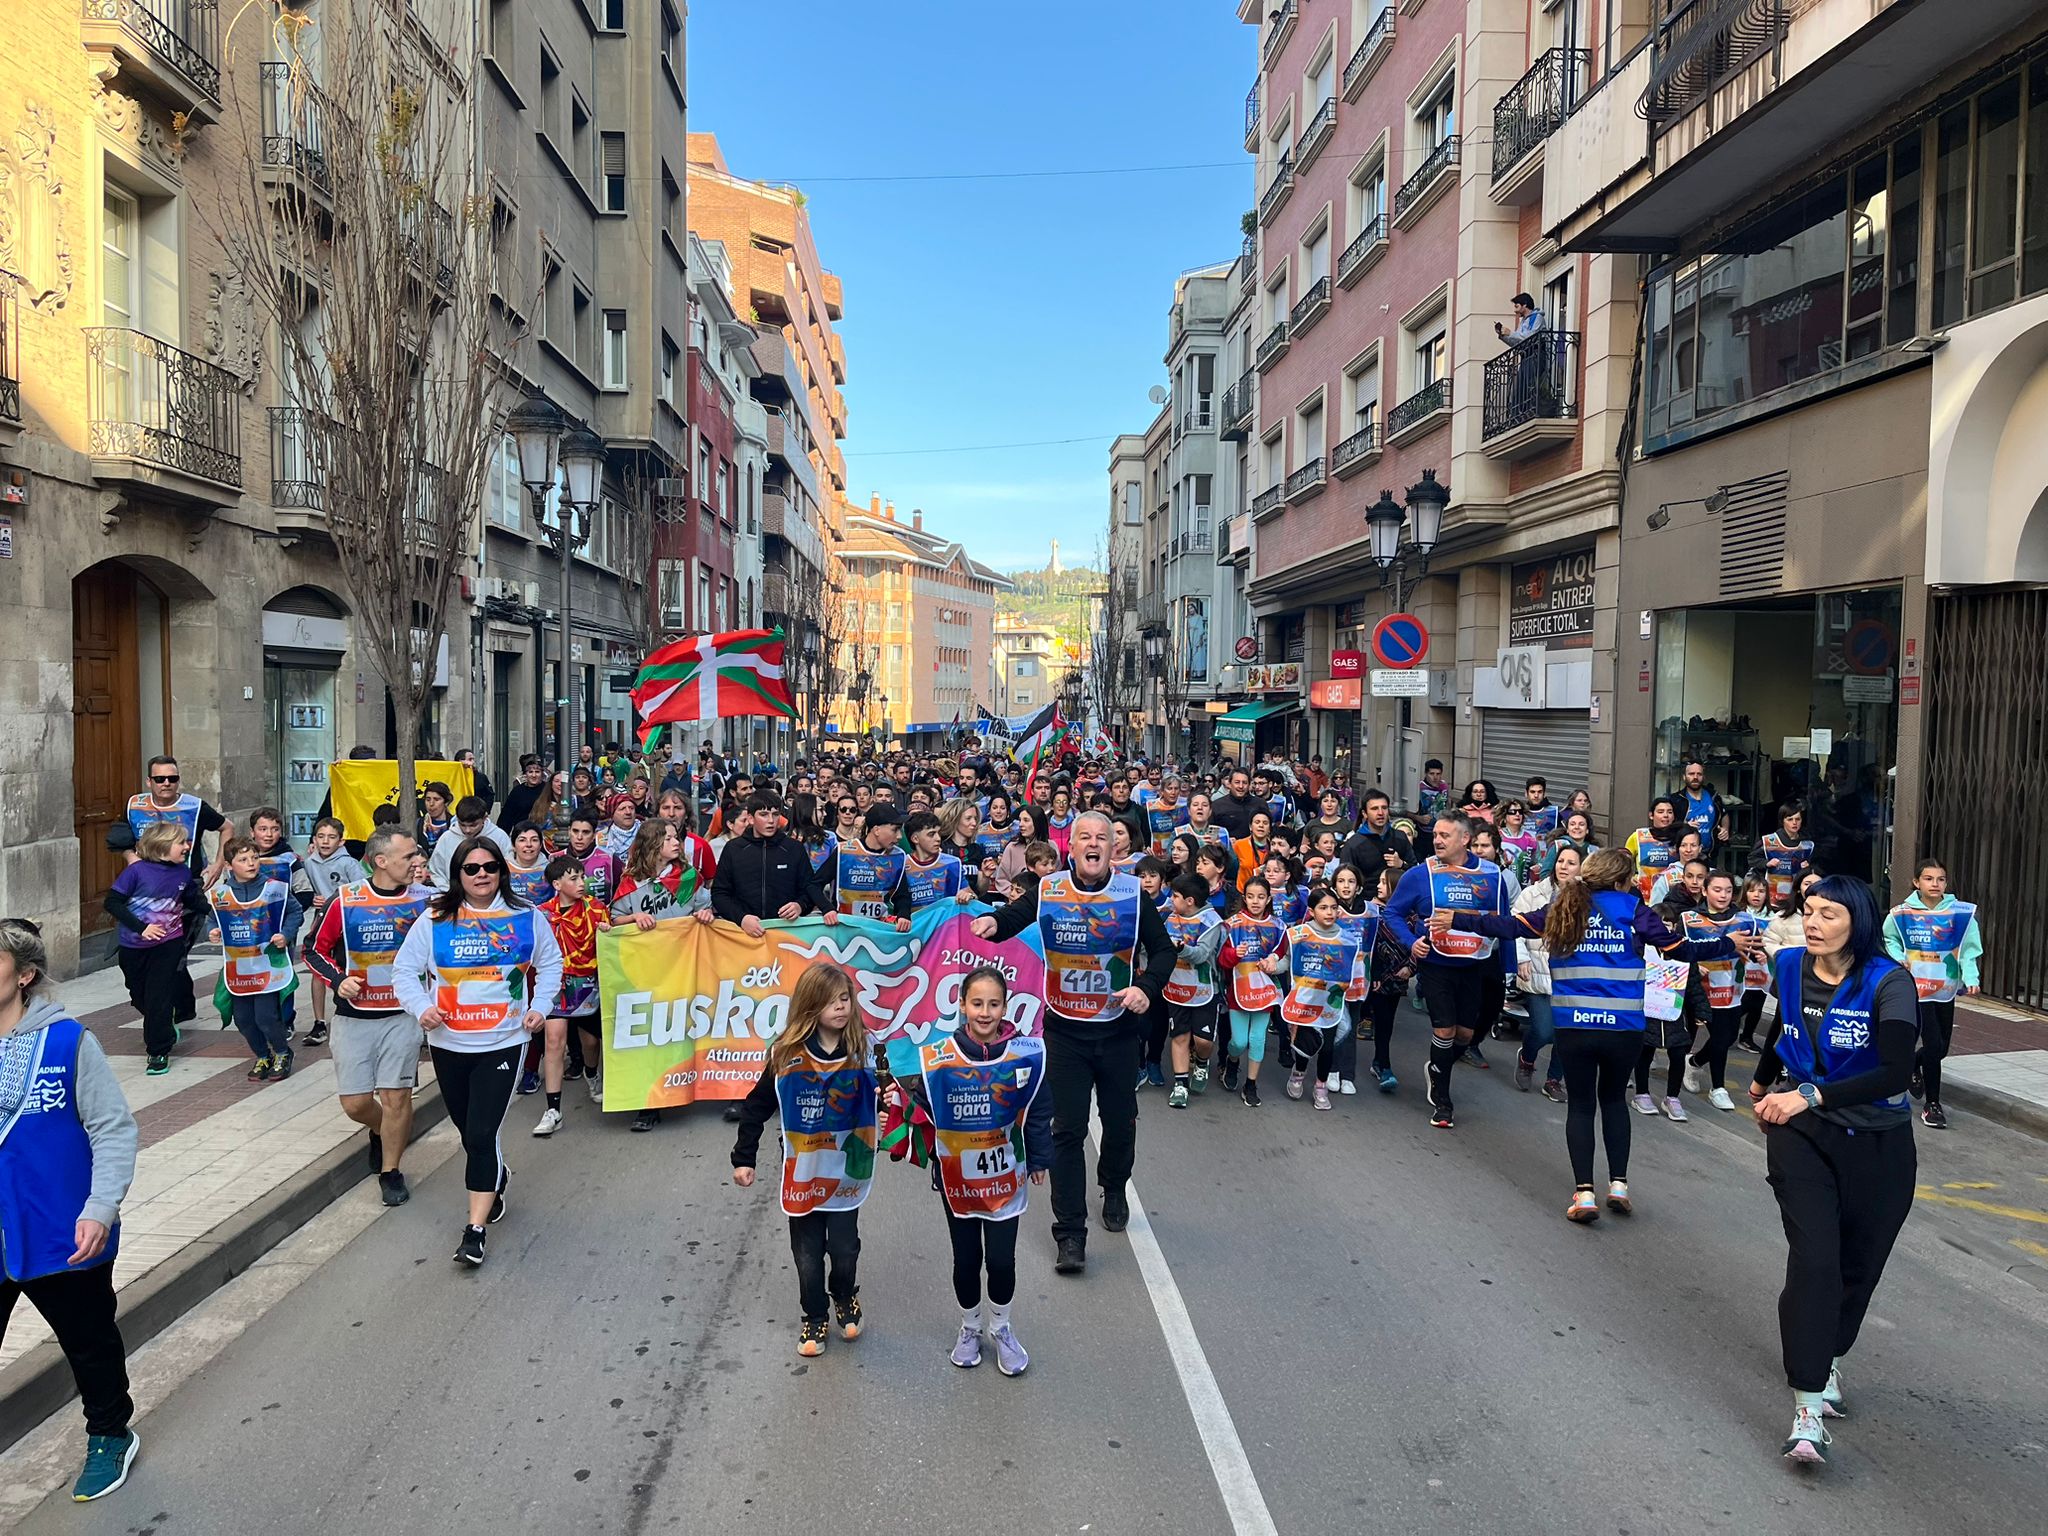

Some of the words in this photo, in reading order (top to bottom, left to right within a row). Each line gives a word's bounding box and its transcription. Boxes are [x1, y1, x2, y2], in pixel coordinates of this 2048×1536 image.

[1511, 616, 1551, 638] SUPERFICIE
[1552, 612, 1579, 633] TOTAL
[1333, 659, 1358, 667] GAES
[243, 687, 253, 700] 10
[1327, 685, 1343, 704] GAES
[851, 874, 874, 885] gara
[911, 889, 933, 901] gara
[1448, 892, 1472, 902] gara
[860, 902, 882, 917] 416
[1052, 922, 1087, 932] Euskara
[1588, 913, 1603, 928] ek
[358, 924, 394, 933] Euskara
[1585, 926, 1624, 940] orrika
[362, 931, 394, 944] gara
[450, 938, 487, 947] Euskara
[1055, 931, 1087, 944] gara
[1910, 933, 1931, 943] gara
[454, 945, 488, 959] gara
[740, 957, 783, 988] aek
[1063, 969, 1108, 992] 412
[1050, 995, 1098, 1010] 24.korrika
[444, 1008, 499, 1021] 24.korrika
[613, 980, 790, 1050] Euska
[1573, 1010, 1616, 1025] berria
[1831, 1036, 1852, 1045] gara
[947, 1092, 990, 1104] Euskara
[953, 1102, 991, 1120] gara
[977, 1147, 1009, 1175] 412
[949, 1181, 1012, 1199] 24.korrika
